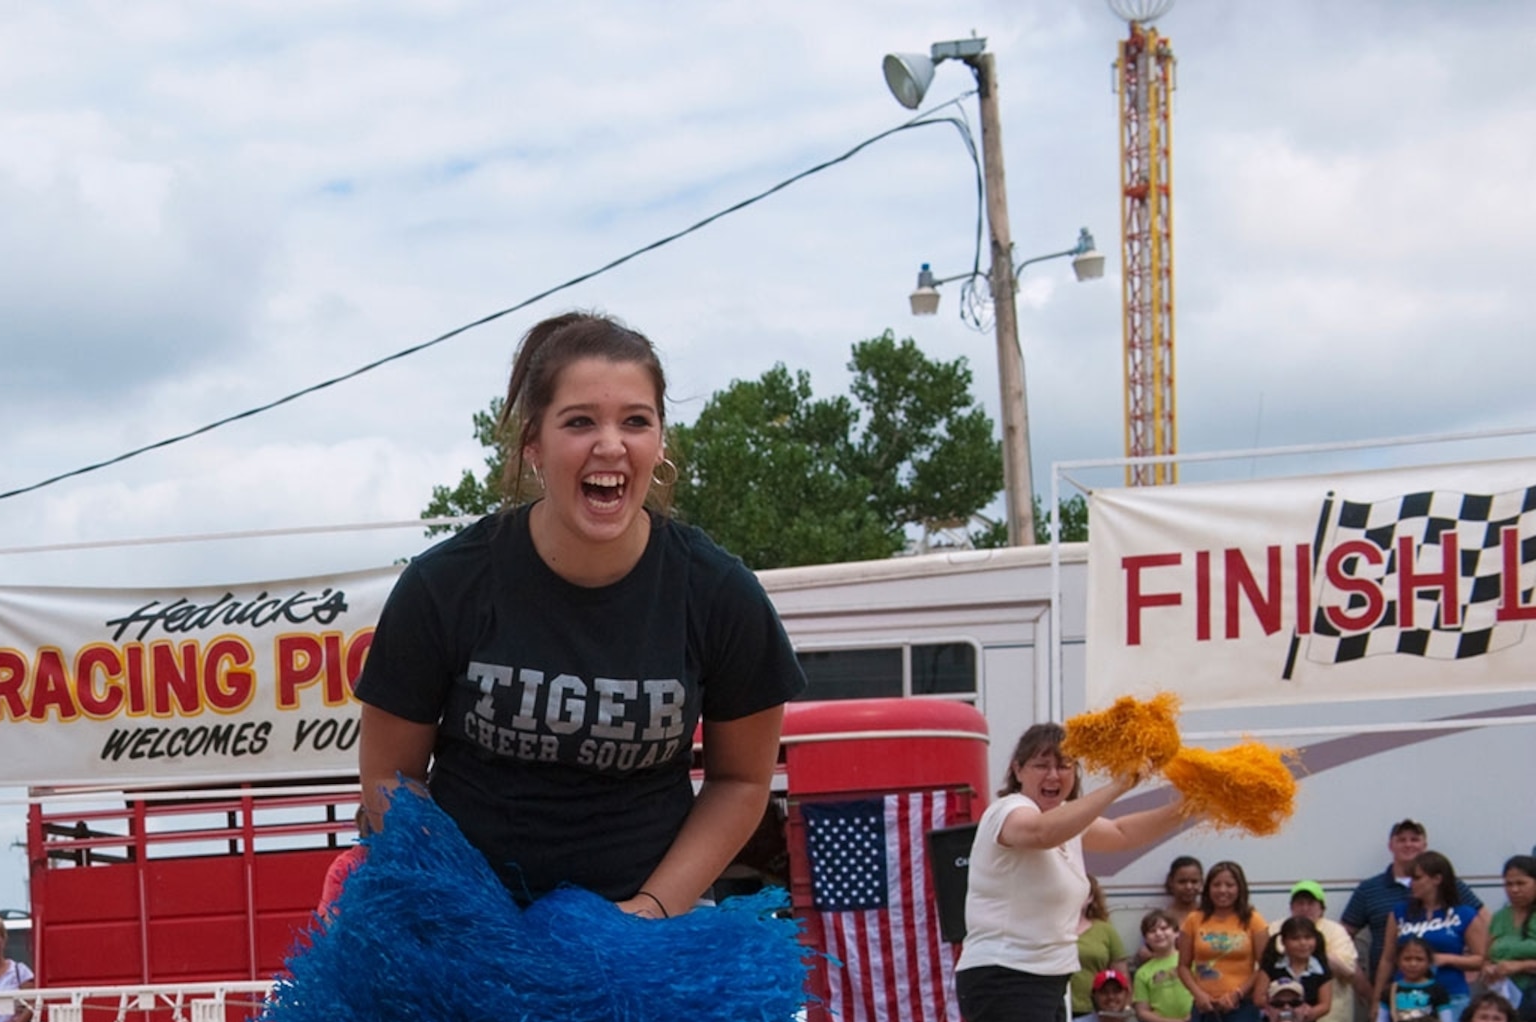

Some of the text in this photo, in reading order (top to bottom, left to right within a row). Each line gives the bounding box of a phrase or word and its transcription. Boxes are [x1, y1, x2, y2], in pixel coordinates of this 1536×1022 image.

[106, 588, 348, 642] Hedrick's
[1121, 531, 1460, 646] FINISH
[467, 661, 686, 741] TIGER
[100, 718, 361, 762] WELCOMES YOU
[464, 711, 681, 771] CHEER SQUAD
